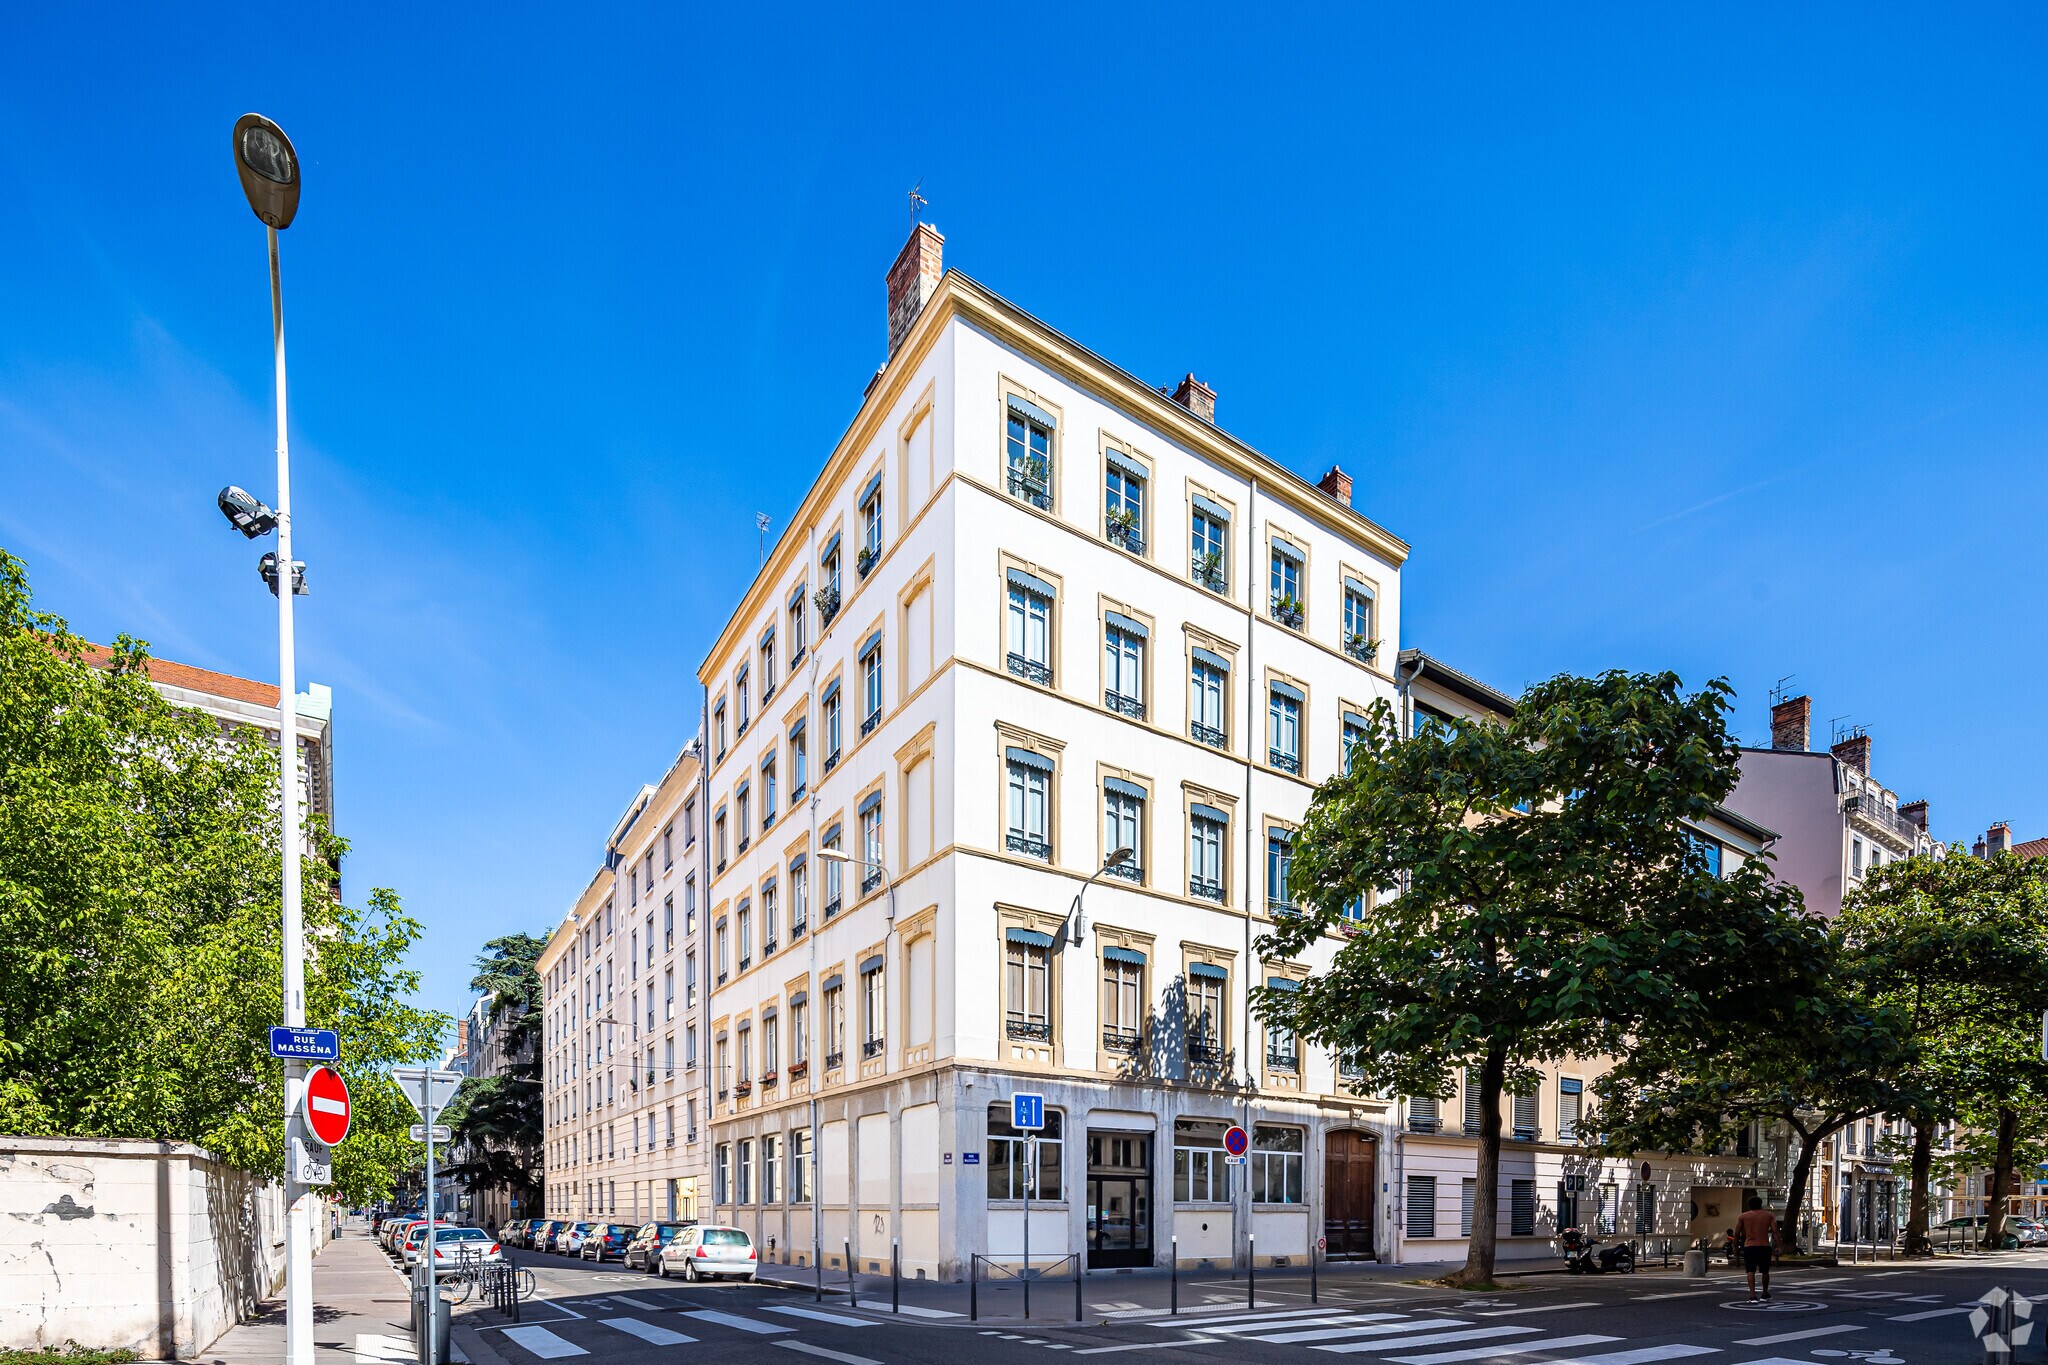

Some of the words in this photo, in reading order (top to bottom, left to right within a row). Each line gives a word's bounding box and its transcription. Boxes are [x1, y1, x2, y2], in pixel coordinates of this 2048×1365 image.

[293, 1035, 316, 1044] RUE
[277, 1043, 332, 1055] MASSÉNA
[304, 1142, 323, 1153] SAUF
[1568, 1177, 1573, 1188] P
